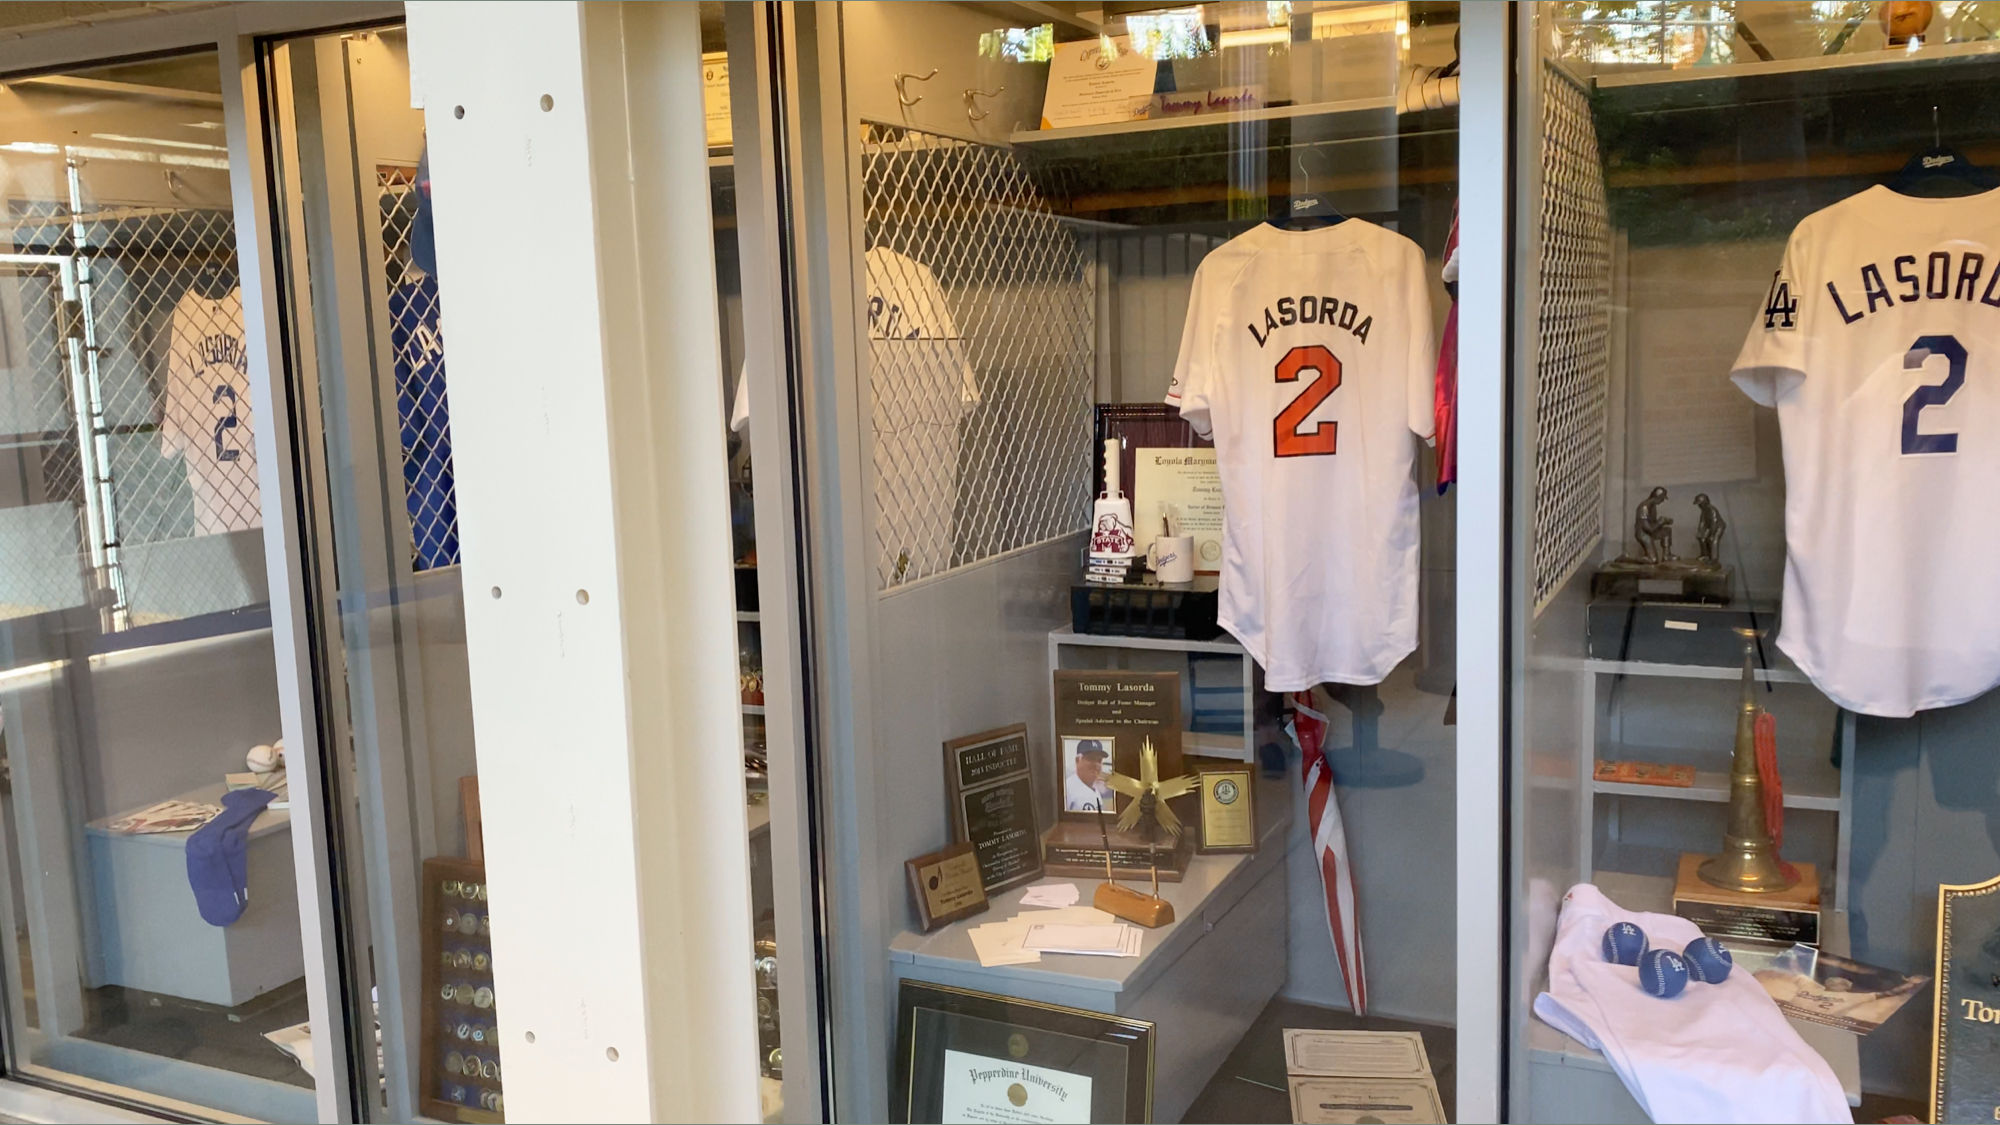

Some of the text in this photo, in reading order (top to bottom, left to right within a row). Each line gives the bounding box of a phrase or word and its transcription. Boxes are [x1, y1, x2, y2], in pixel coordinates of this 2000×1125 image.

[1248, 296, 1373, 348] LASORDA
[1273, 344, 1343, 458] 2
[1901, 335, 1969, 454] 2
[212, 385, 240, 461] 2
[1154, 456, 1183, 467] Loyola
[1079, 682, 1155, 693] Tommy Lasorda
[968, 1067, 1069, 1103] Pepperdine University
